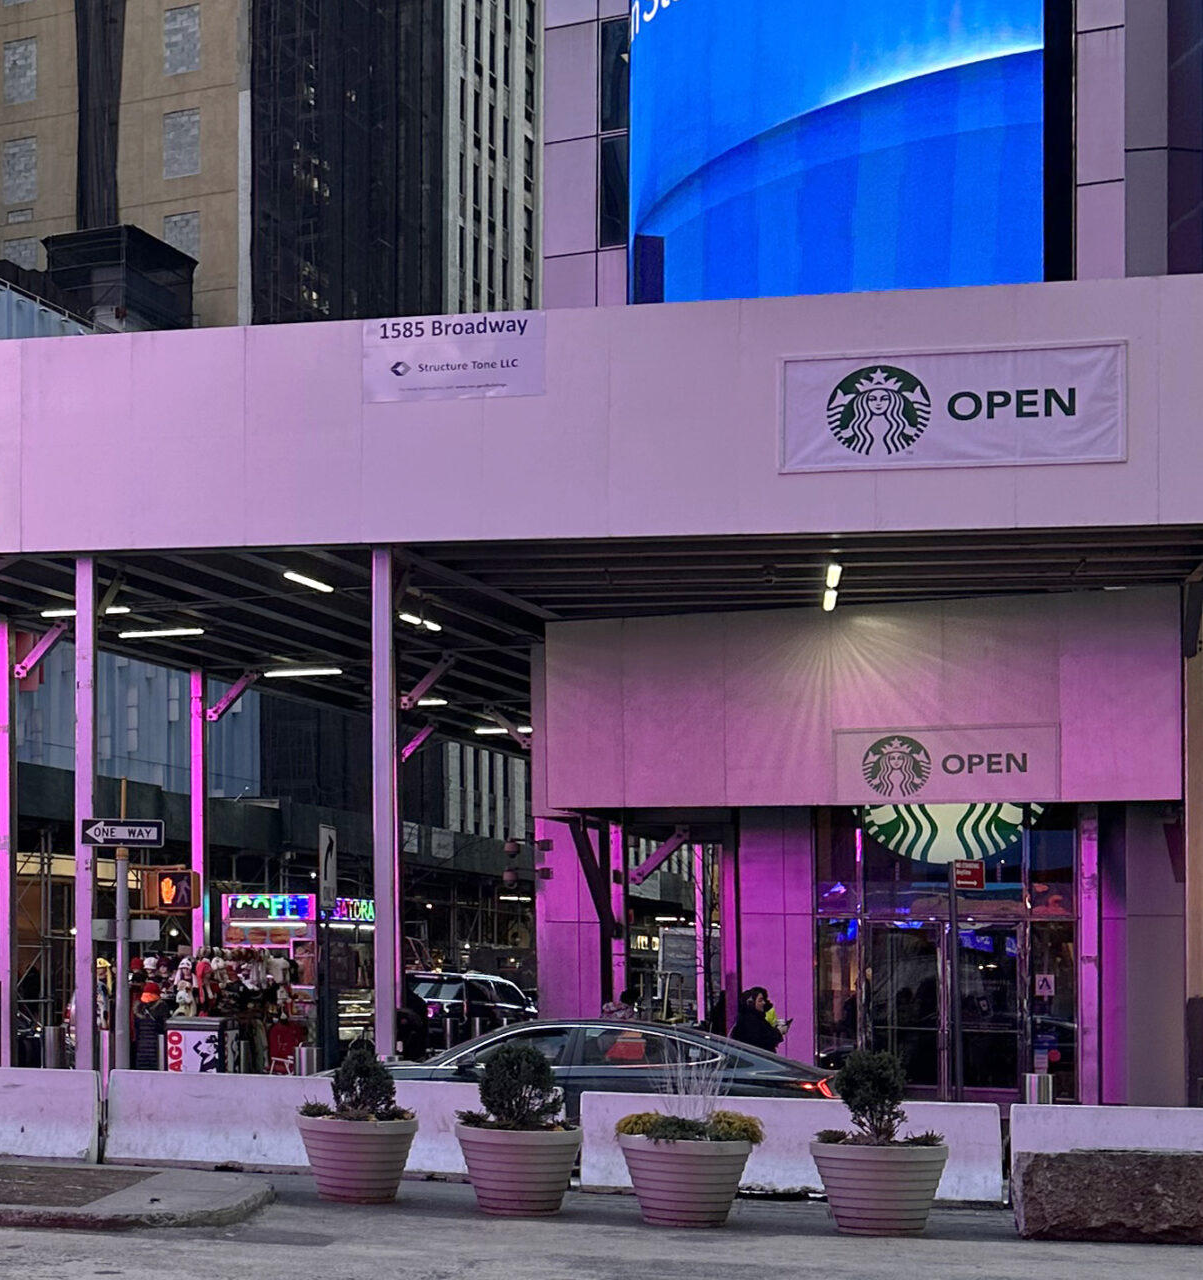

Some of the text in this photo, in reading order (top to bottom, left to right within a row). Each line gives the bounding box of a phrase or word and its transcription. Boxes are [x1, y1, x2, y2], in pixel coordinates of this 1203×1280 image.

[380, 316, 528, 339] 1585 Broadway
[418, 358, 519, 372] Structure Tone LLC
[947, 387, 1076, 421] OPEN
[941, 752, 1028, 774] OPEN
[94, 827, 153, 838] ONE WAY
